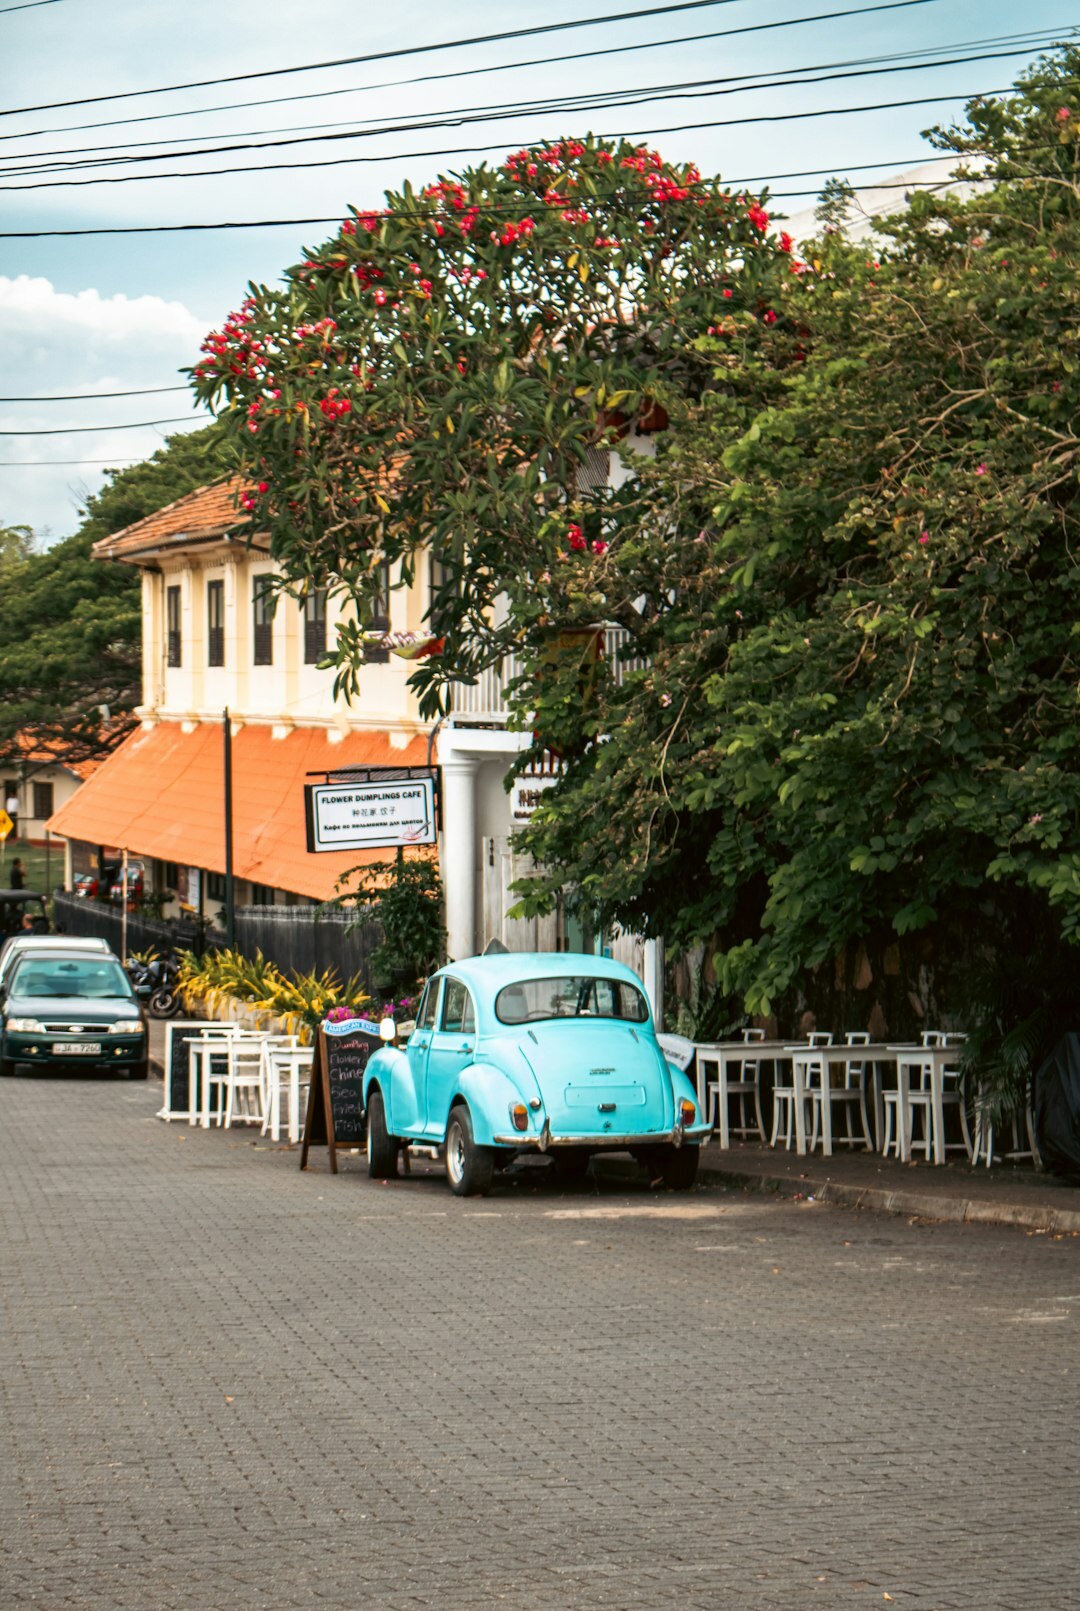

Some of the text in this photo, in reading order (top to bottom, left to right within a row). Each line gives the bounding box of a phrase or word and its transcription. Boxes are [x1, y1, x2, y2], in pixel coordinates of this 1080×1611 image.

[321, 790, 422, 804] FLOWER DUMPLINGS CAFE
[334, 1119, 363, 1133] Fish
